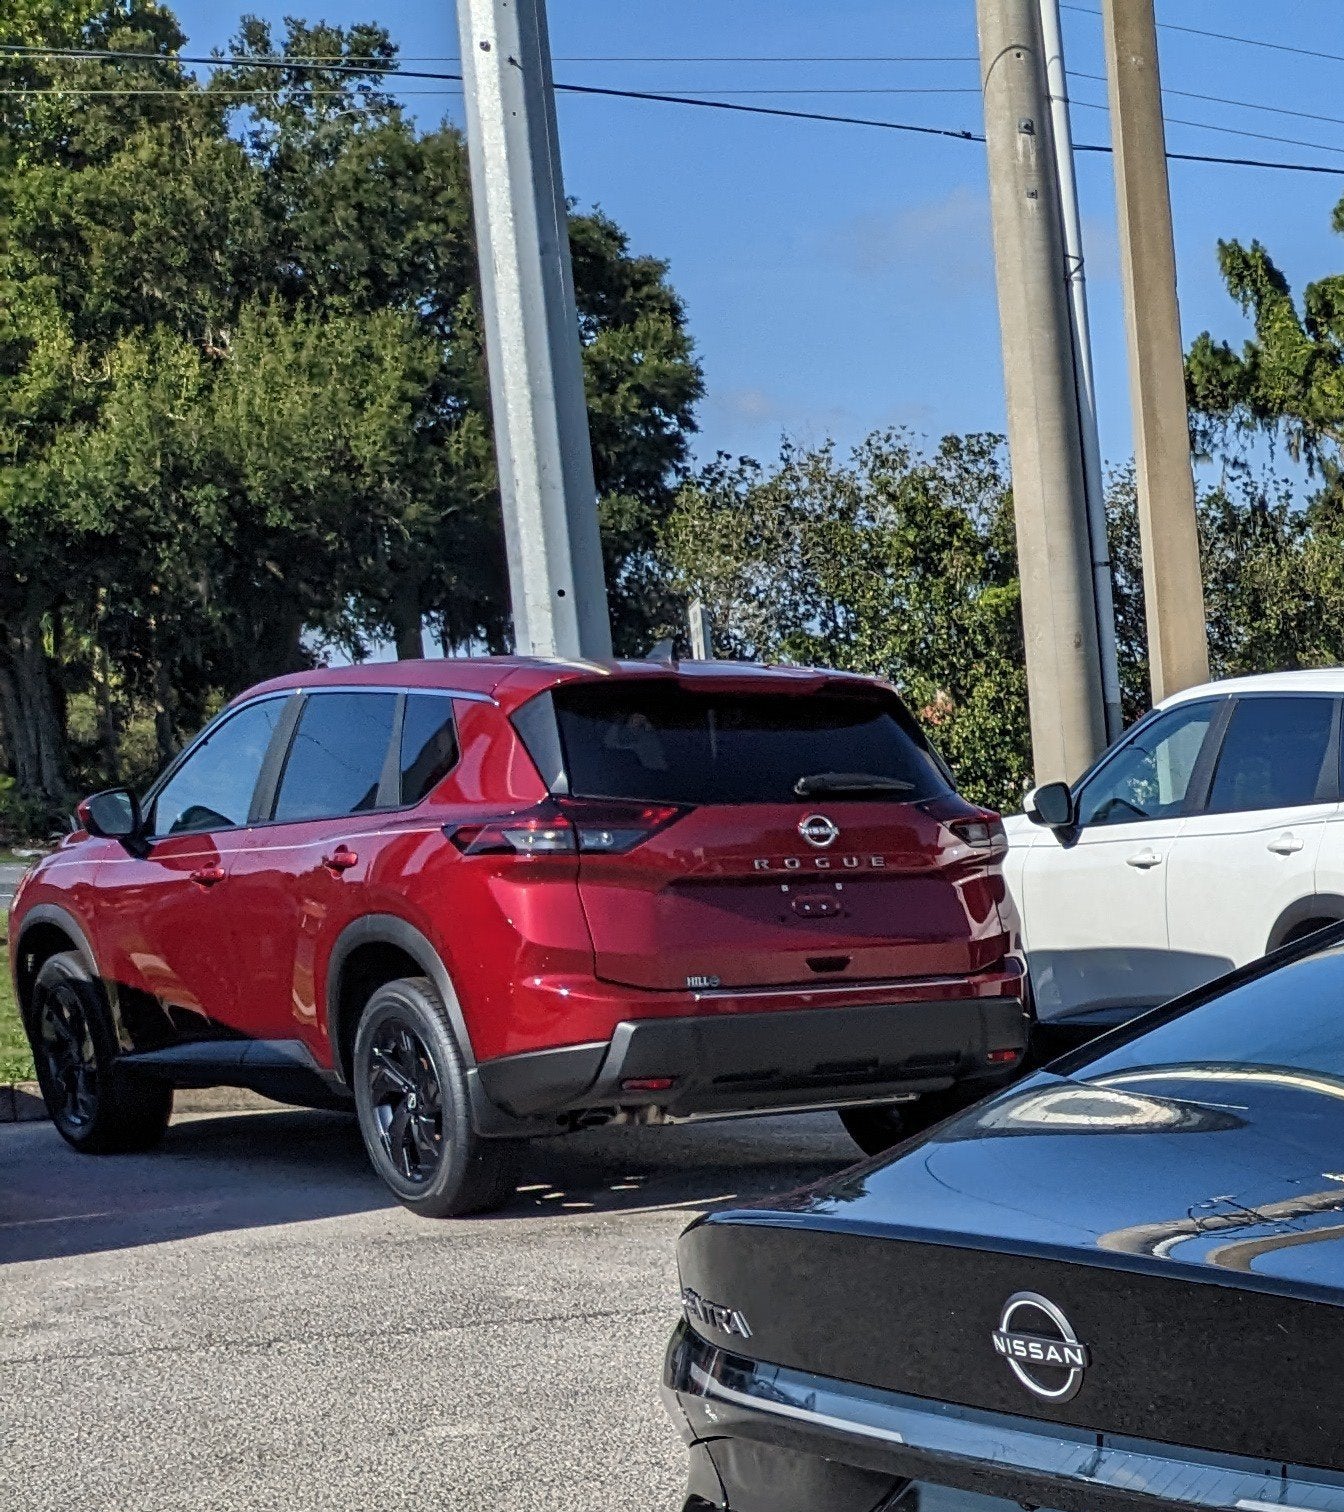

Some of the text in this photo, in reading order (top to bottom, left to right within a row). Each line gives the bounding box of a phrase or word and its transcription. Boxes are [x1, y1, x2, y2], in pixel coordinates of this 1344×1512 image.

[753, 856, 885, 870] ROGUE
[686, 976, 709, 987] HILL
[992, 1334, 1083, 1365] NISSAN
